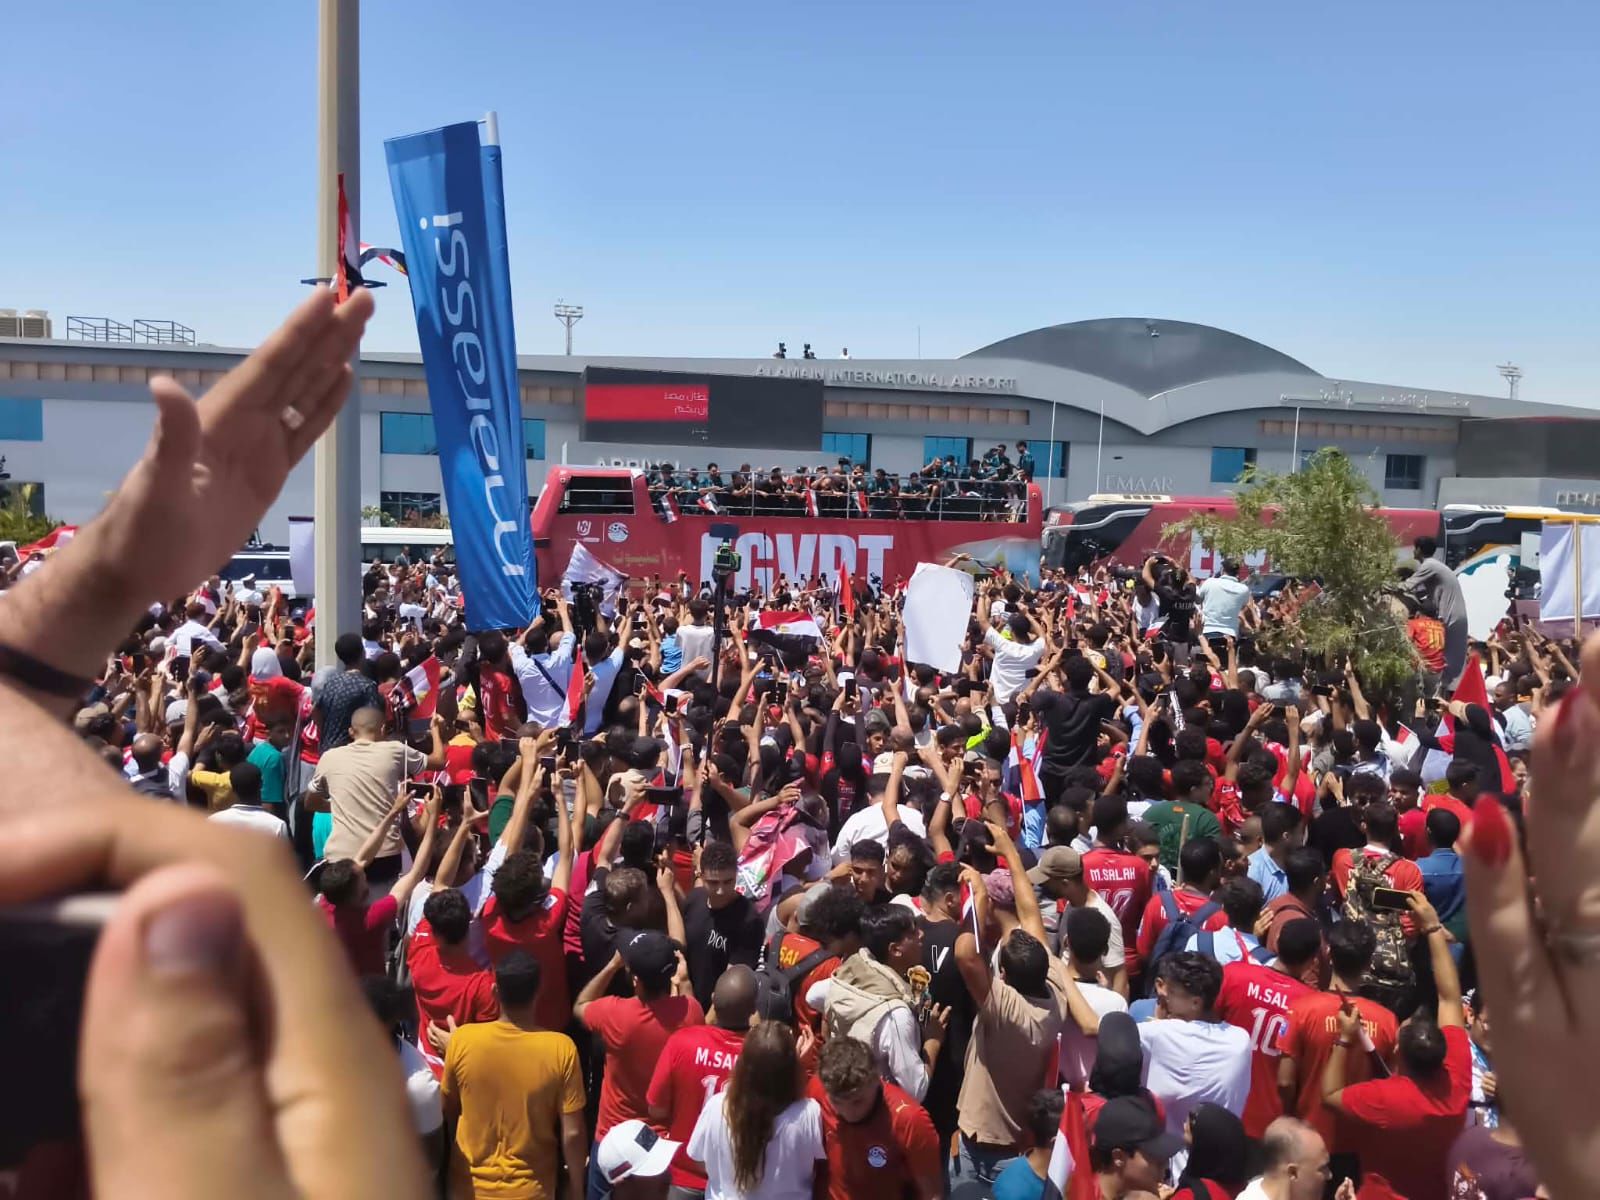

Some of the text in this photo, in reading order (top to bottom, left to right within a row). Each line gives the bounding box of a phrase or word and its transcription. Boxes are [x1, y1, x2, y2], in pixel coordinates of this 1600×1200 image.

[829, 369, 948, 388] INTERNATIONAL
[950, 374, 1018, 390] AIRPORT
[419, 212, 525, 577] marassi
[1105, 474, 1175, 492] EMAAR
[1090, 867, 1136, 882] M.SALAH
